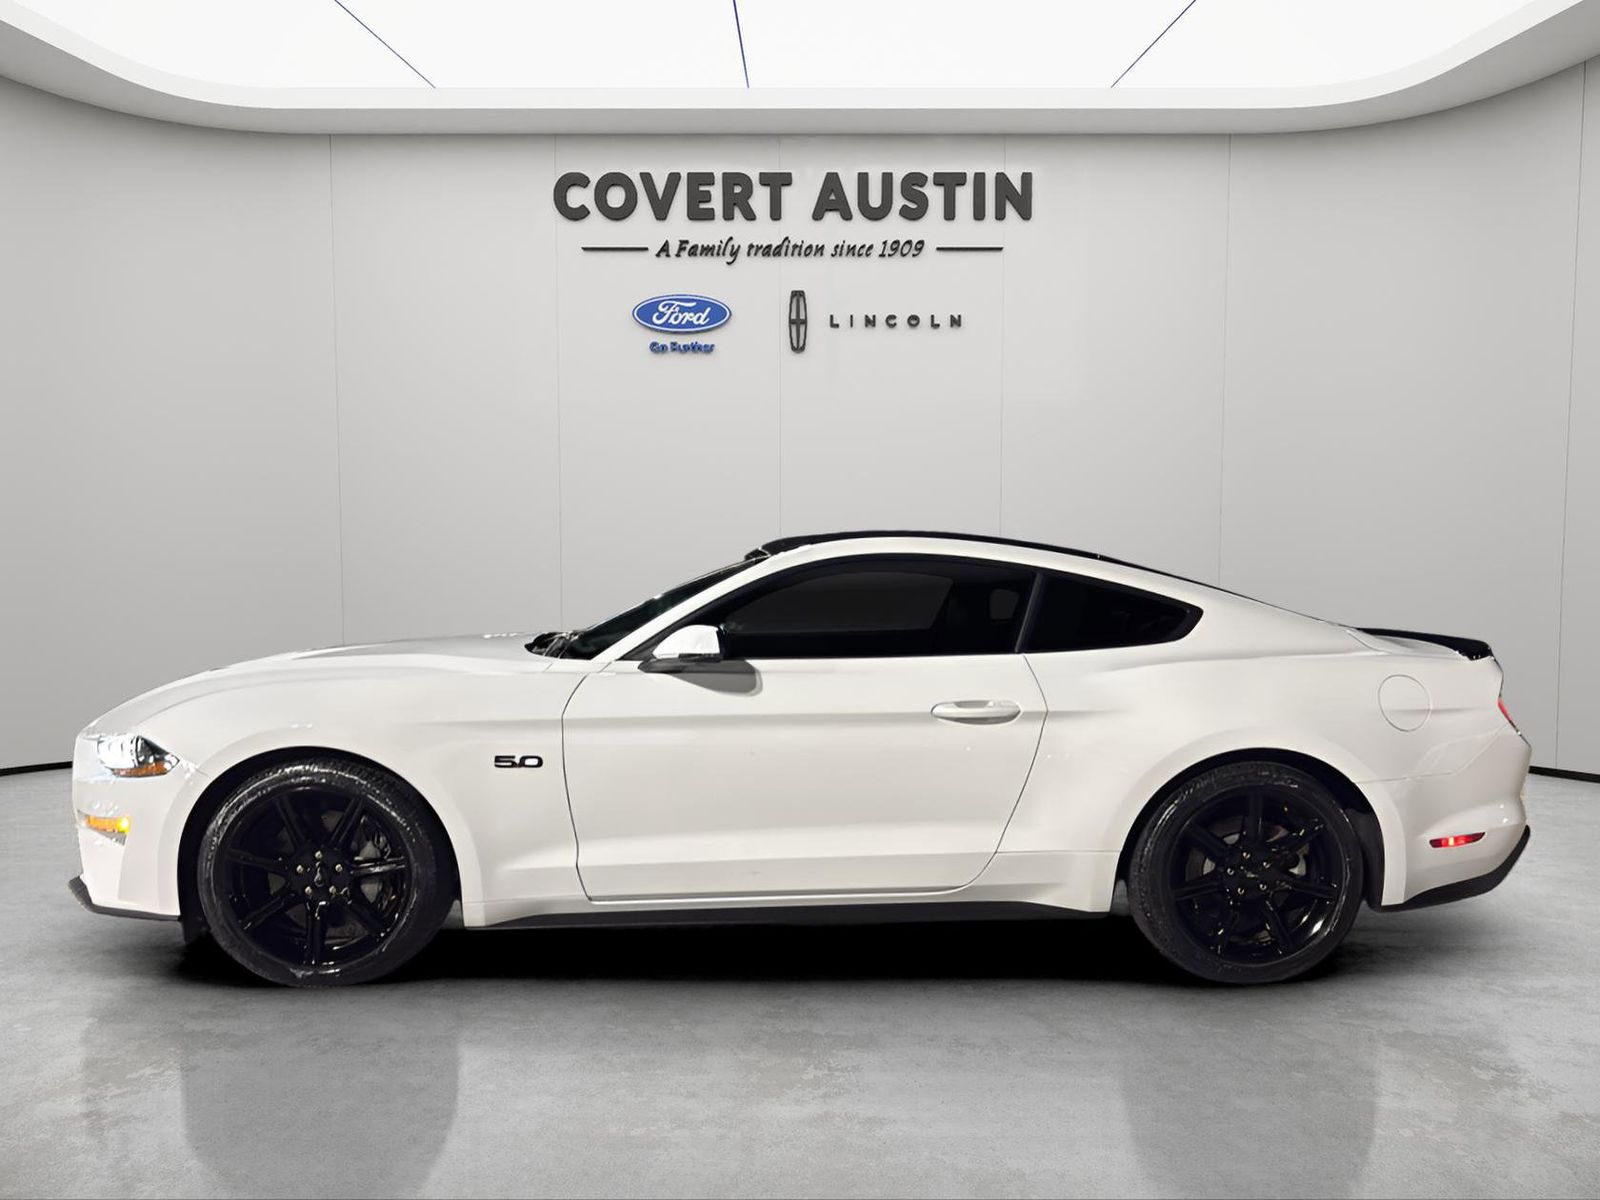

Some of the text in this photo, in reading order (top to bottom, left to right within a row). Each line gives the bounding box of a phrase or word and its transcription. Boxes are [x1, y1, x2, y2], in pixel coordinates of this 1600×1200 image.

[553, 171, 1033, 222] COVERT AUSTIN
[655, 236, 925, 266] A Family tradition since 1909
[652, 300, 711, 325] Ford
[828, 313, 963, 330] LINCOLN
